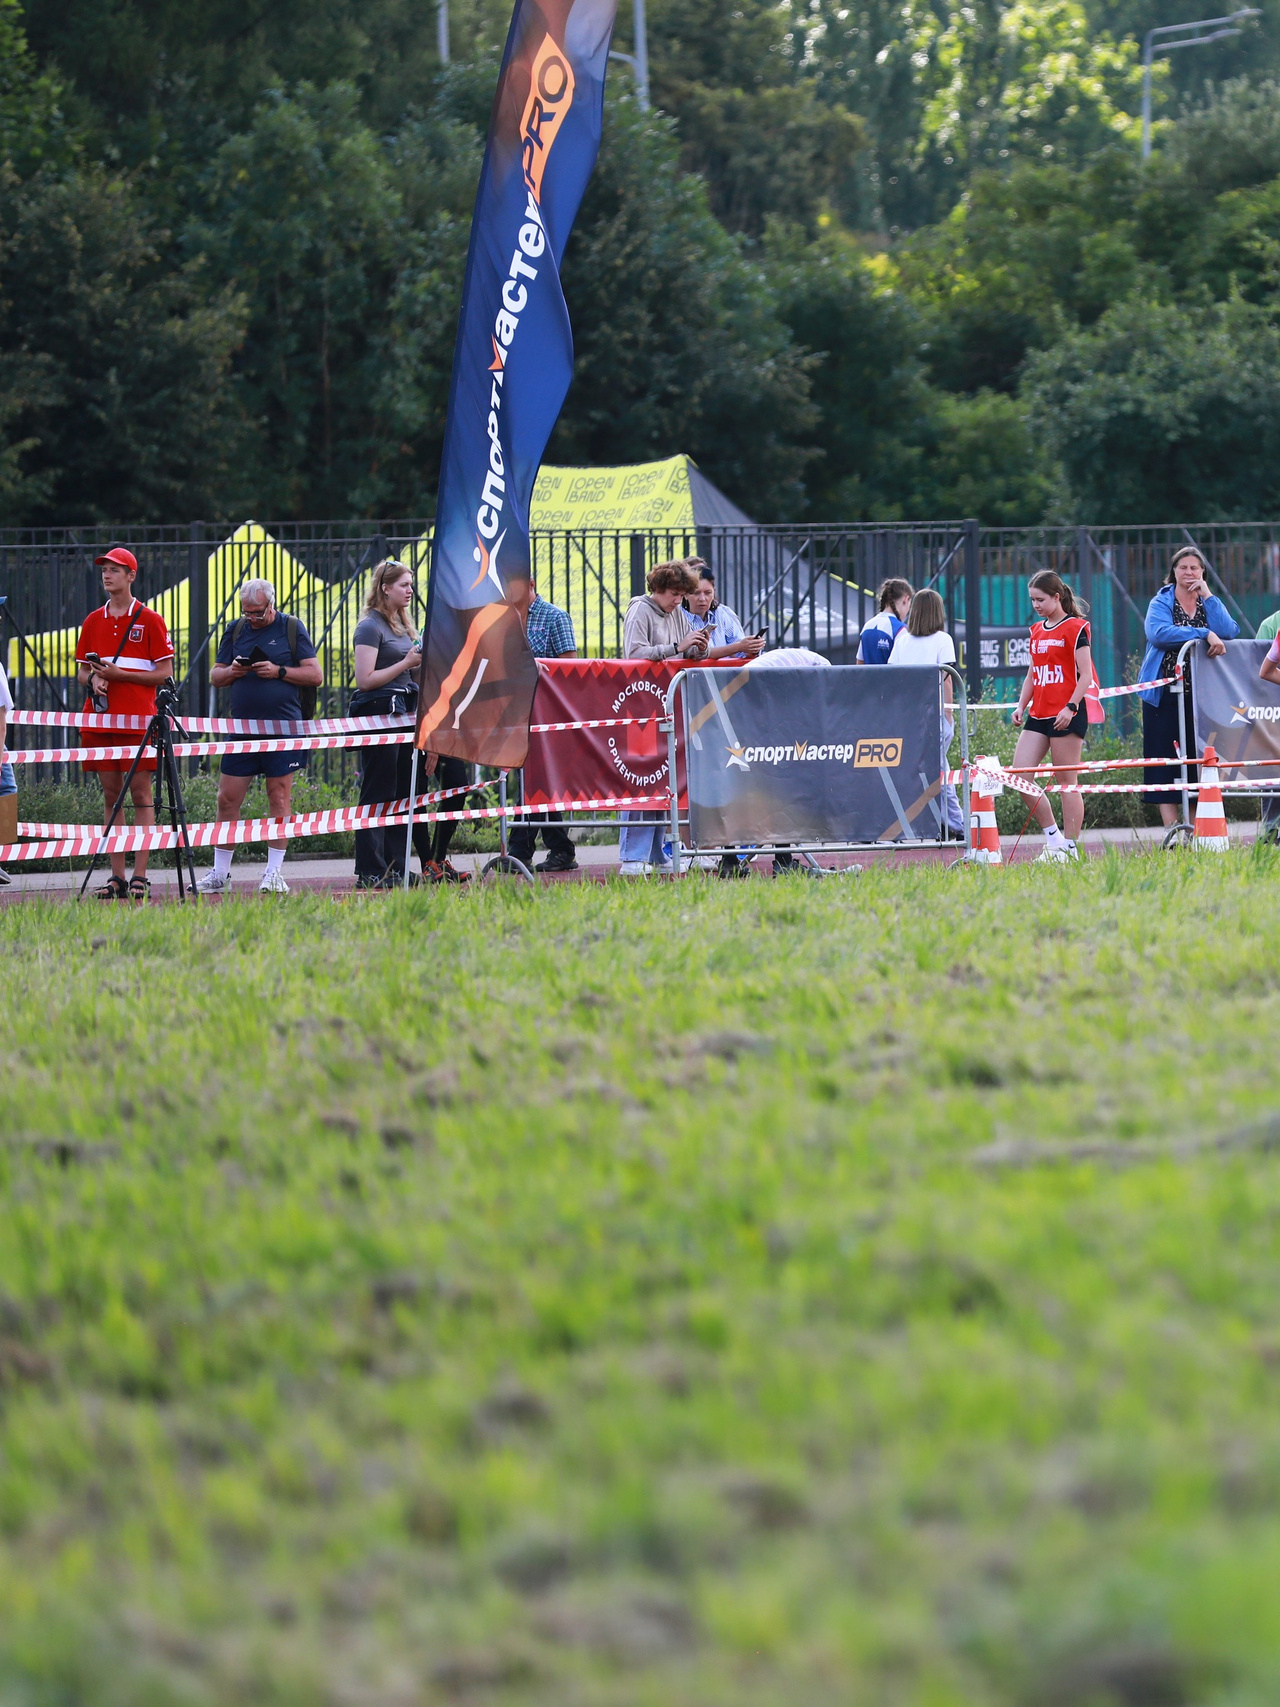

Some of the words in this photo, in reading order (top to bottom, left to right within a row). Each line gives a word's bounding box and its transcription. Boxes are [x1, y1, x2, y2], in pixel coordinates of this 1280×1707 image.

[522, 55, 568, 190] PRO
[612, 681, 668, 713] МОСКОВСКО
[608, 738, 672, 786] ОРИЕНТИРОВА
[857, 743, 899, 763] PRO
